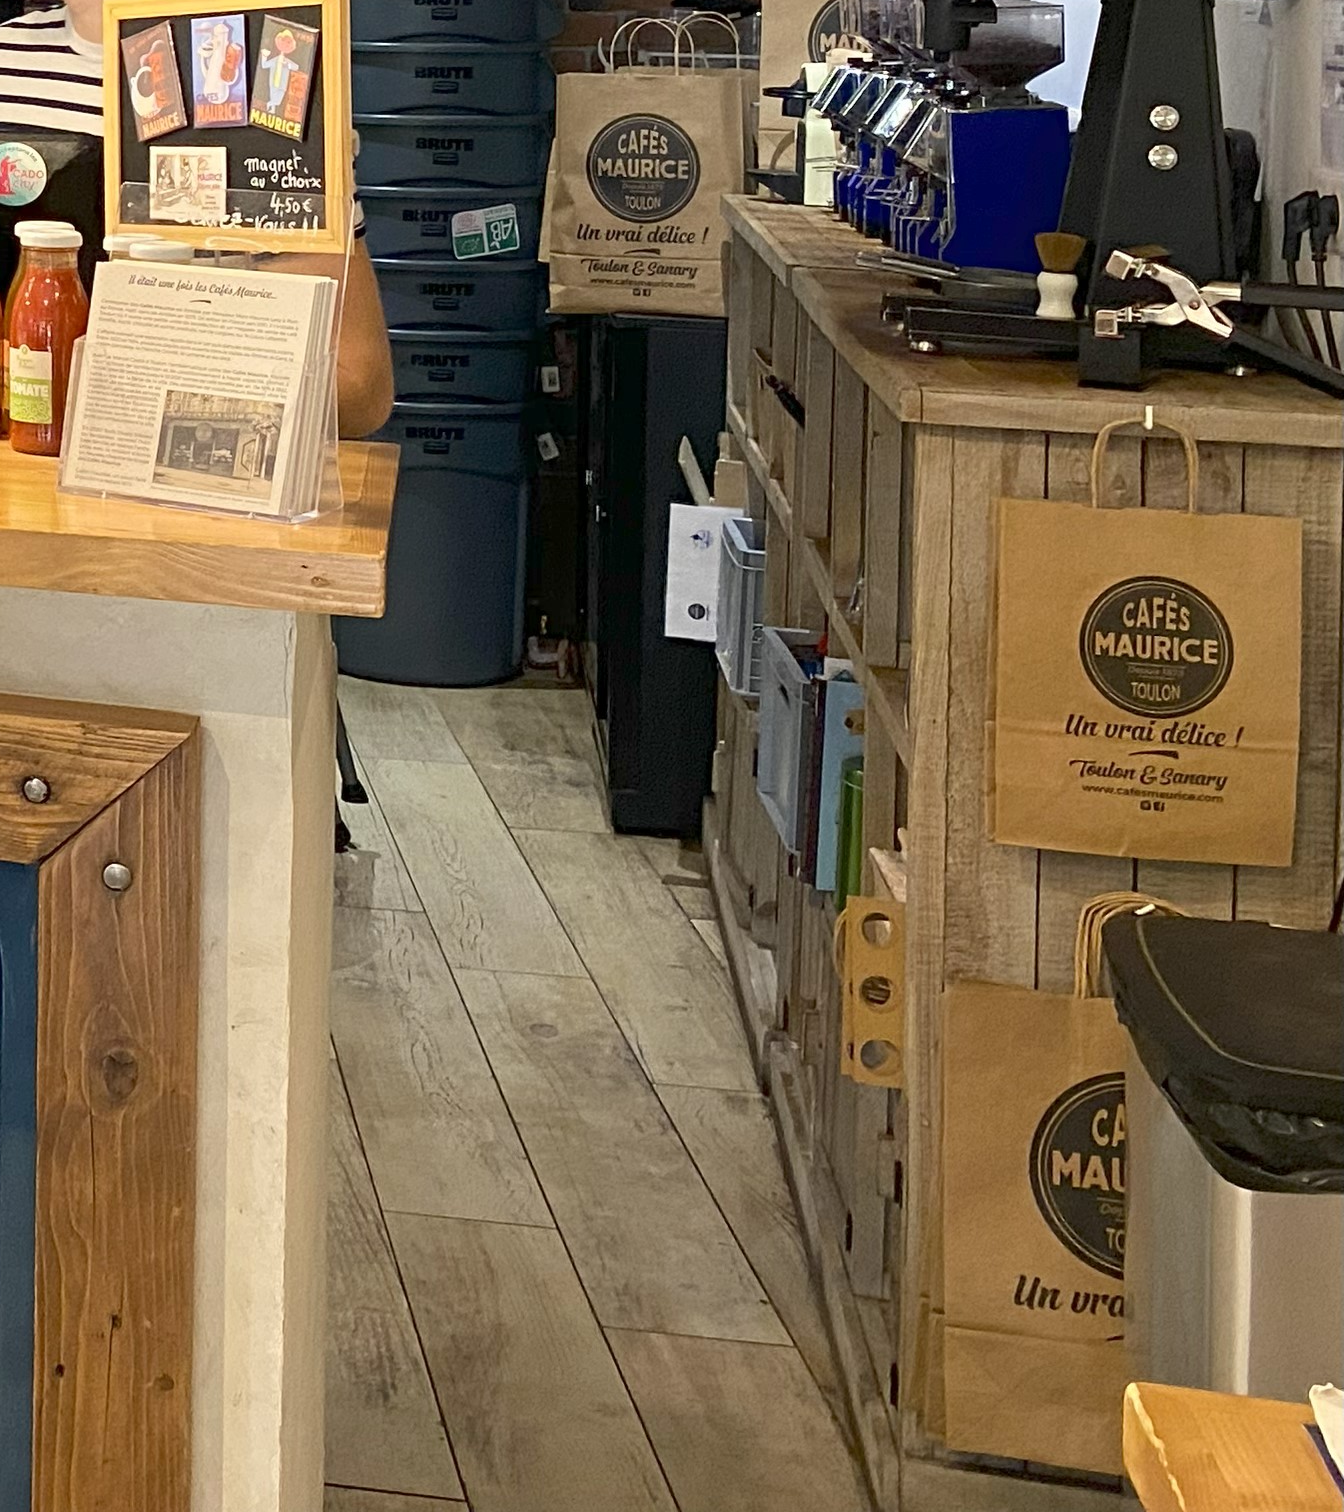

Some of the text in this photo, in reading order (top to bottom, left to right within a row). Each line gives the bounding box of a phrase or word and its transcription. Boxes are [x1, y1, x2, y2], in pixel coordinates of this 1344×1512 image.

[196, 103, 243, 123] MAURICE
[249, 108, 302, 138] MAURICE
[141, 112, 180, 138] MAURICE
[616, 125, 668, 156] CAFÉS
[13, 169, 44, 180] CADO
[249, 166, 322, 189] au choix
[596, 156, 690, 181] MAURICE
[624, 193, 662, 210] TOULON
[402, 209, 452, 222] BRUT
[576, 222, 710, 245] Un vrai délice !
[580, 258, 698, 280] Toulon & Sanary
[128, 274, 137, 285] Il
[158, 280, 175, 289] une
[175, 279, 194, 292] fois
[195, 281, 207, 293] les
[208, 283, 233, 296] Cafés
[12, 381, 50, 398] OMATE
[1122, 591, 1191, 632] CAFÉS
[1094, 630, 1219, 666] MAURICE
[1130, 680, 1182, 703] TOULON
[1064, 713, 1245, 748] Un vrai délice !
[1068, 759, 1229, 792] Toulon & Sanary
[1080, 783, 1225, 805] www.cafesmaurice.com
[1013, 1274, 1125, 1318] Un vra
